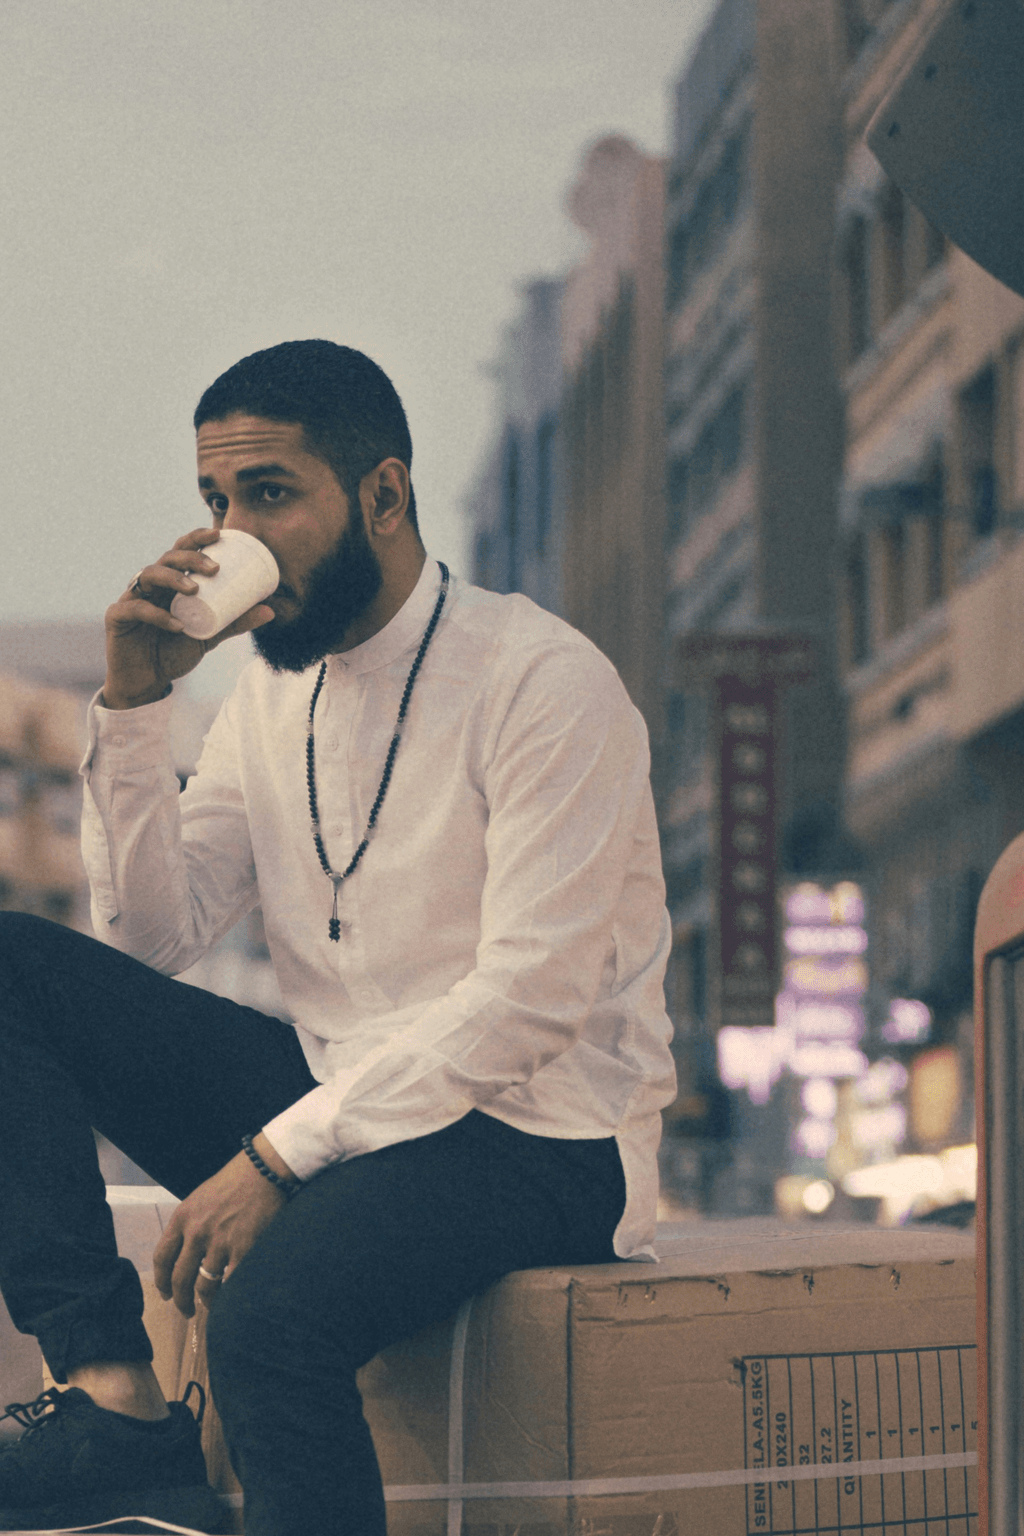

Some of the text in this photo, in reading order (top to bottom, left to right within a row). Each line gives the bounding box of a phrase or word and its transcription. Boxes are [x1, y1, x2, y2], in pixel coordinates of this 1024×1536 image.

[908, 1427, 919, 1436] 1
[929, 1425, 940, 1434] 1
[950, 1424, 961, 1432] 1
[865, 1430, 876, 1439] 1
[887, 1429, 897, 1438] 1
[751, 1361, 766, 1527] SENELA-A5.5KG
[820, 1427, 832, 1464] 27.2
[840, 1399, 855, 1495] QANTITY
[775, 1412, 788, 1490] 20X240
